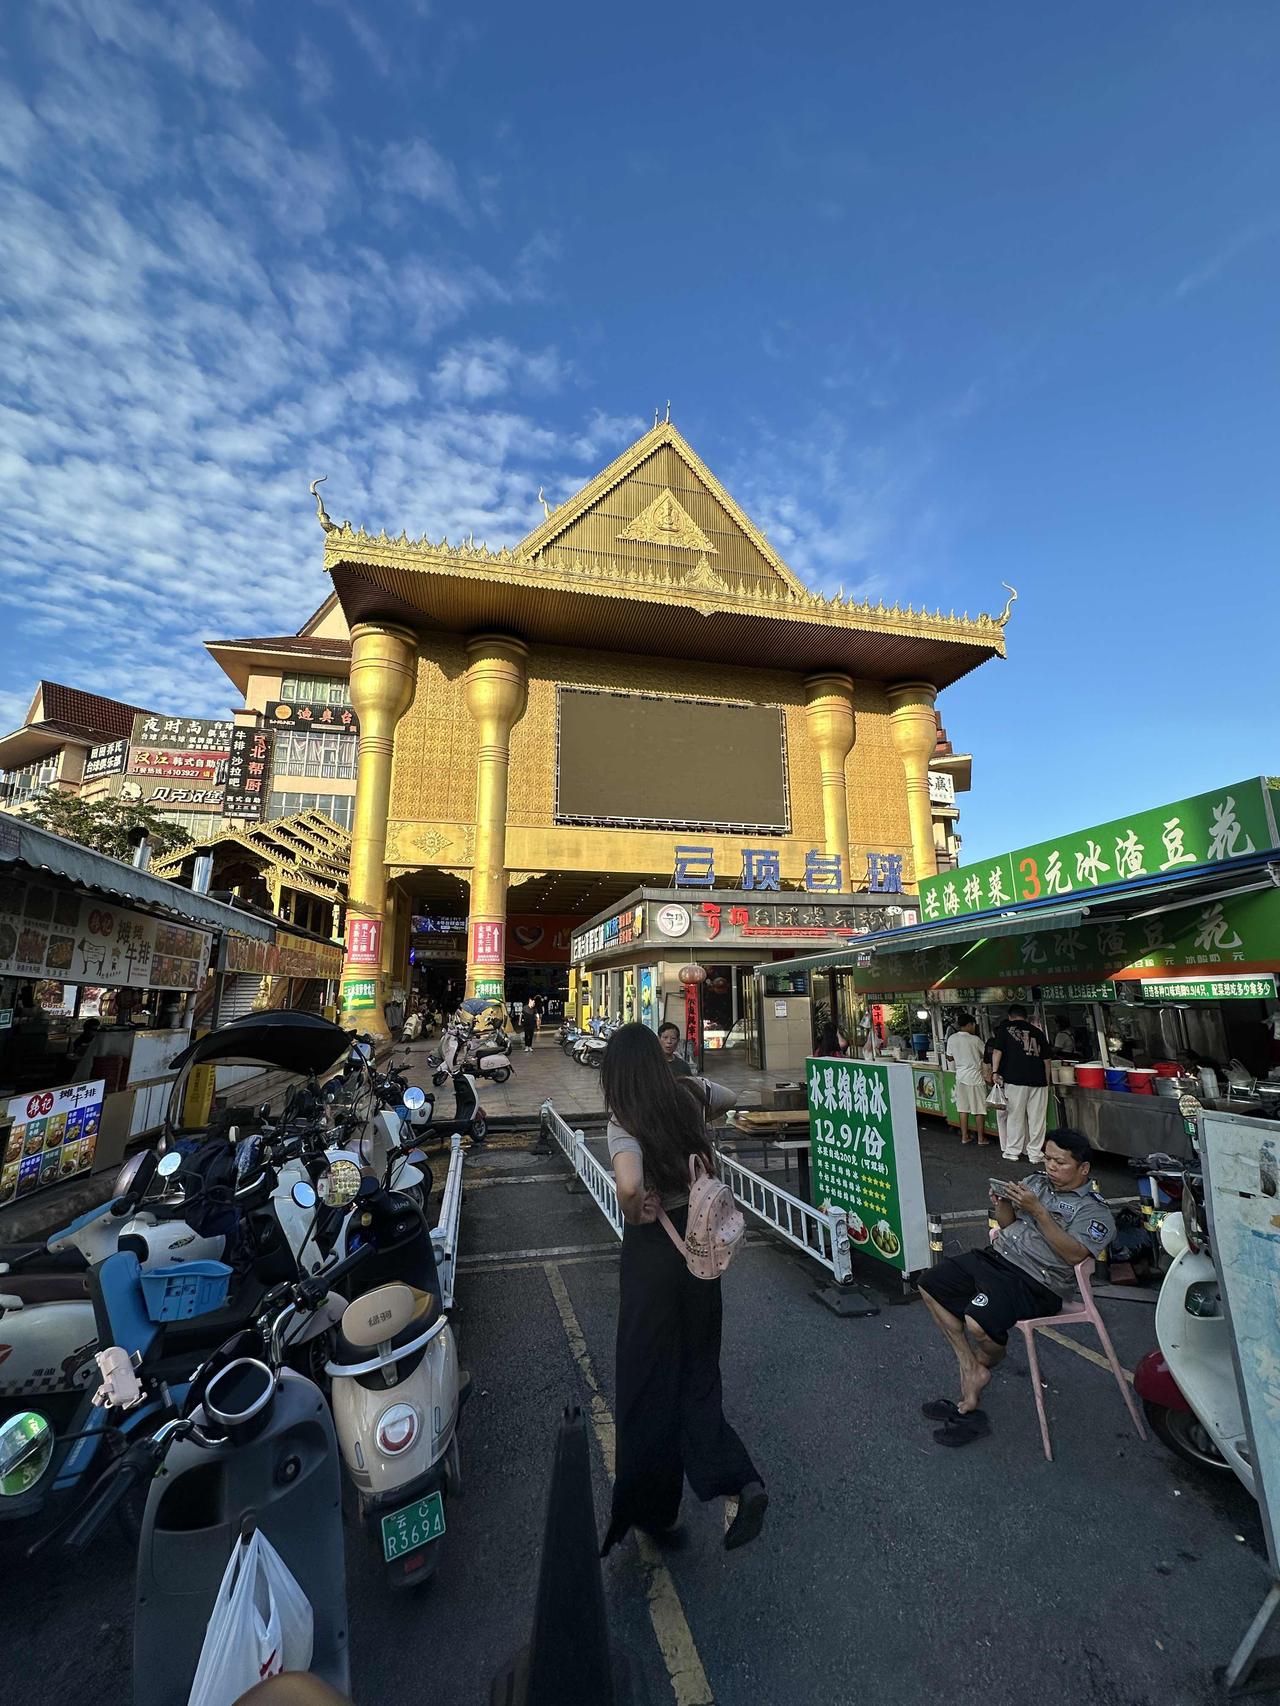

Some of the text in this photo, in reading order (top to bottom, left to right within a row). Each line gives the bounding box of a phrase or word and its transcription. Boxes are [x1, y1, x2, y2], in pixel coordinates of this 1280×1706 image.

[208, 729, 233, 738] 俱乐
[674, 845, 903, 893] 云顶台球
[1019, 796, 1256, 900] 3元冰渣豆花
[810, 1064, 887, 1122] 水果绵绵冰
[815, 1119, 886, 1159] 12.9/份
[388, 1513, 441, 1556] R3694
